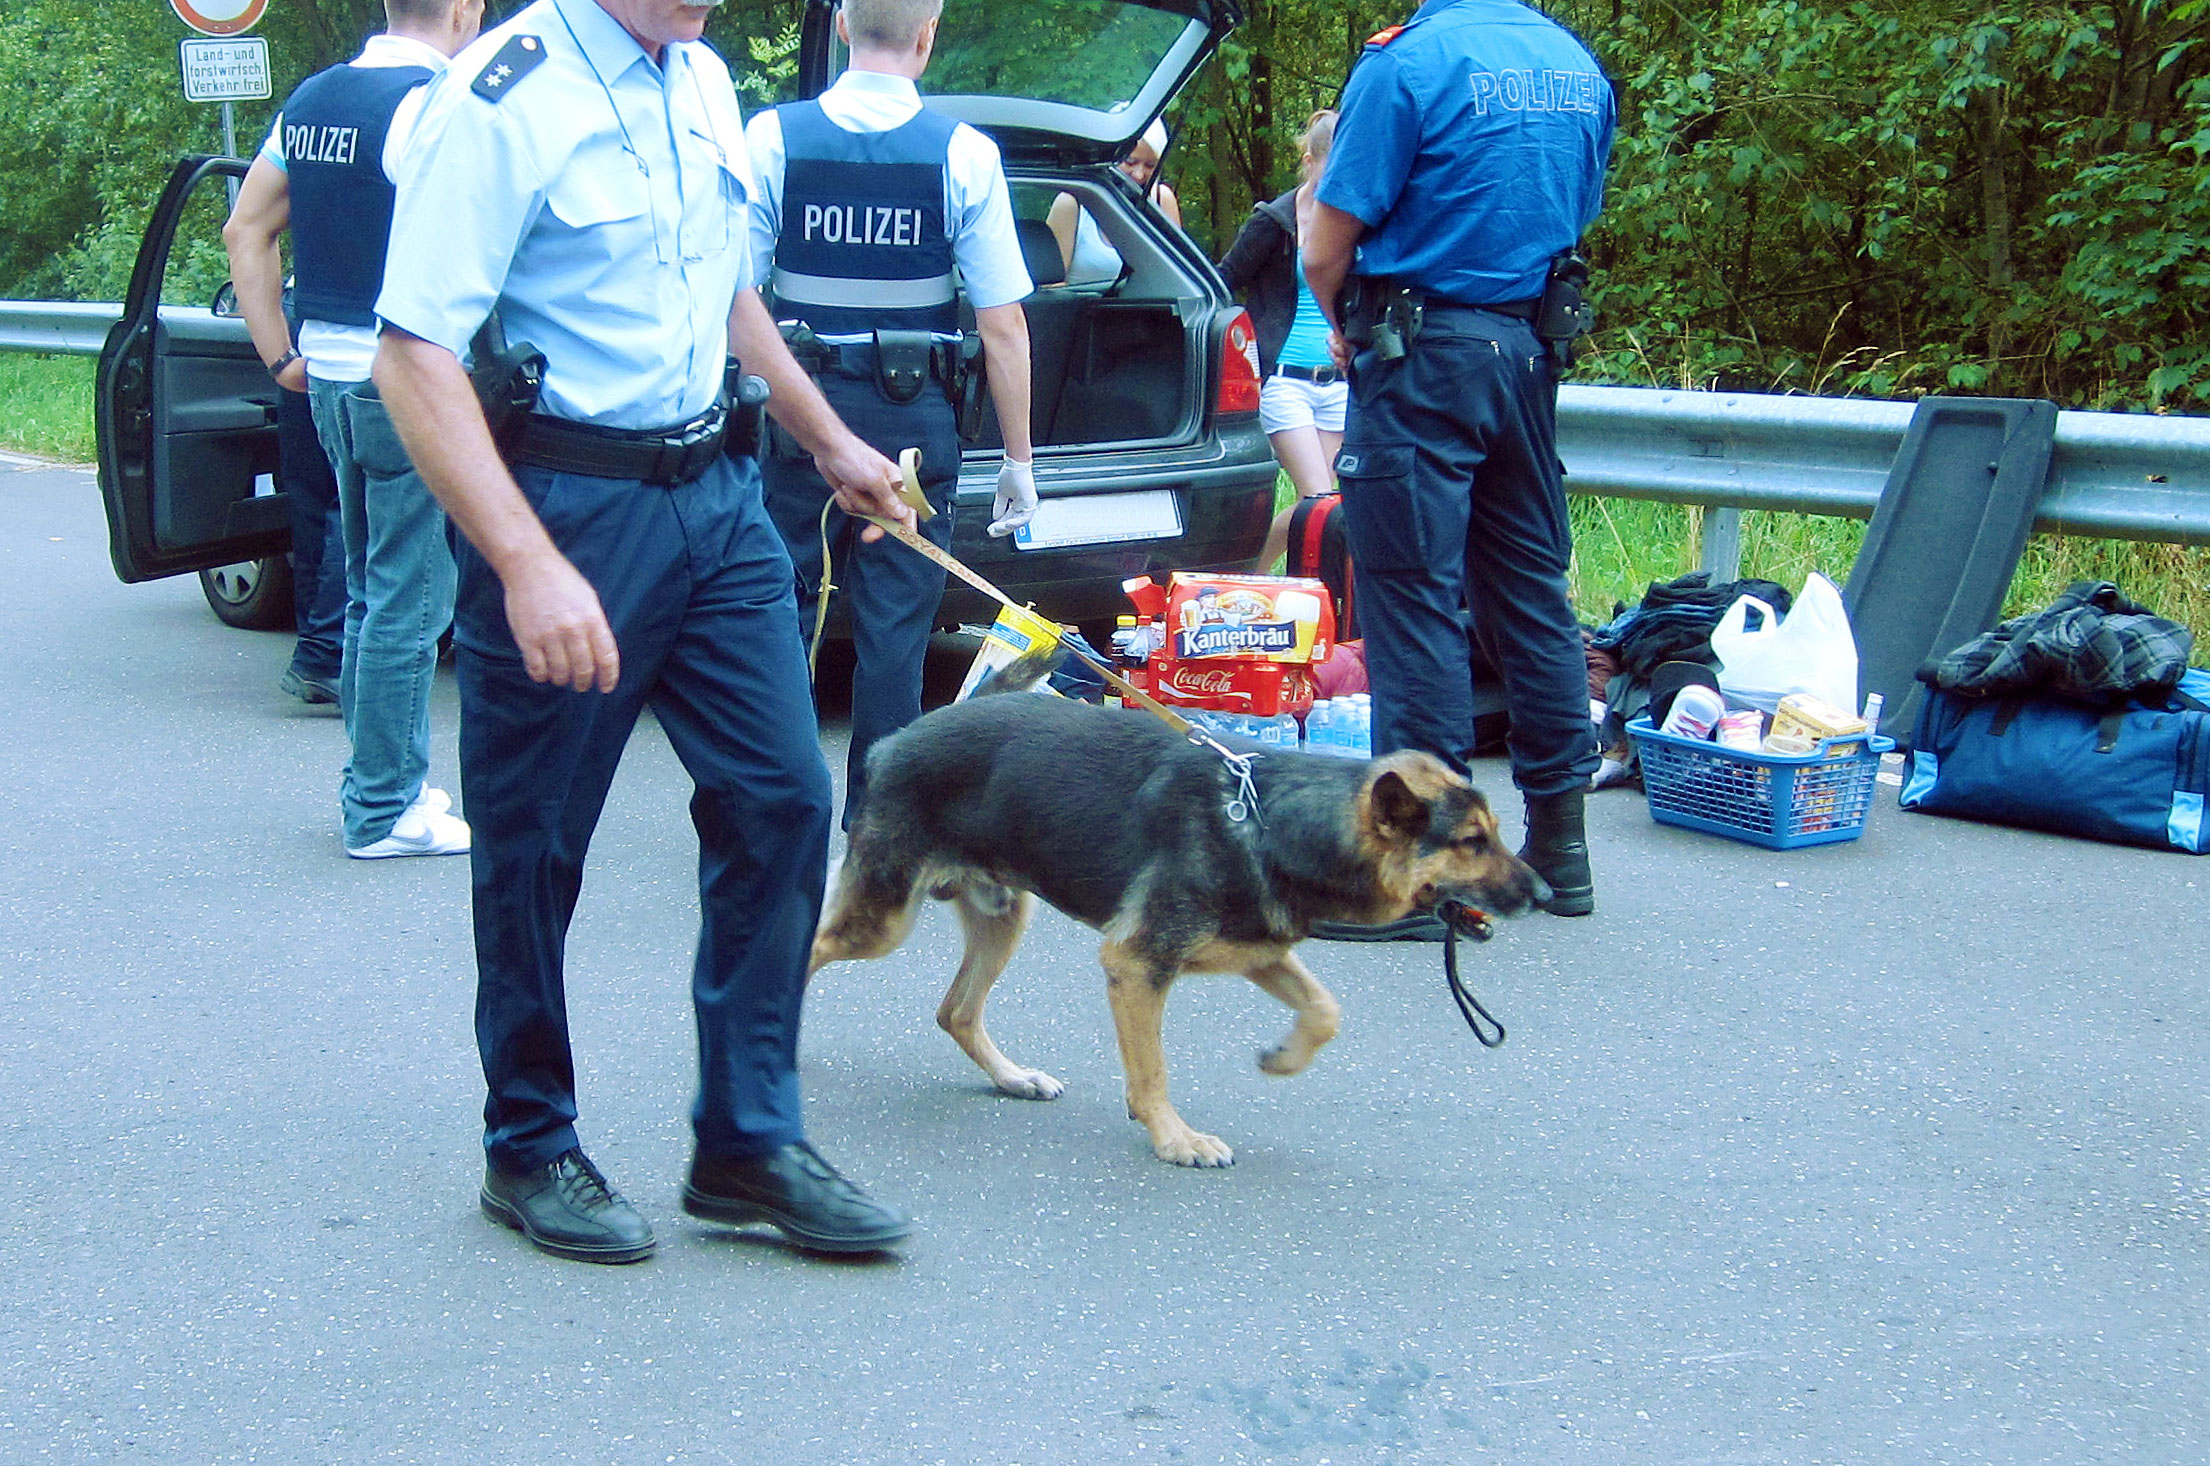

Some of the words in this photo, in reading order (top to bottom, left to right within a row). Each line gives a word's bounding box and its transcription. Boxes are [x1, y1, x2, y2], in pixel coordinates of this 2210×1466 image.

[195, 47, 231, 61] Land-
[233, 46, 255, 60] und
[193, 79, 240, 93] Verkehr
[243, 77, 265, 91] frei
[1469, 68, 1600, 116] POLIZEI
[285, 124, 359, 164] POLIZEI
[803, 203, 922, 246] POLIZEI
[1182, 625, 1291, 657] Kanterbräu
